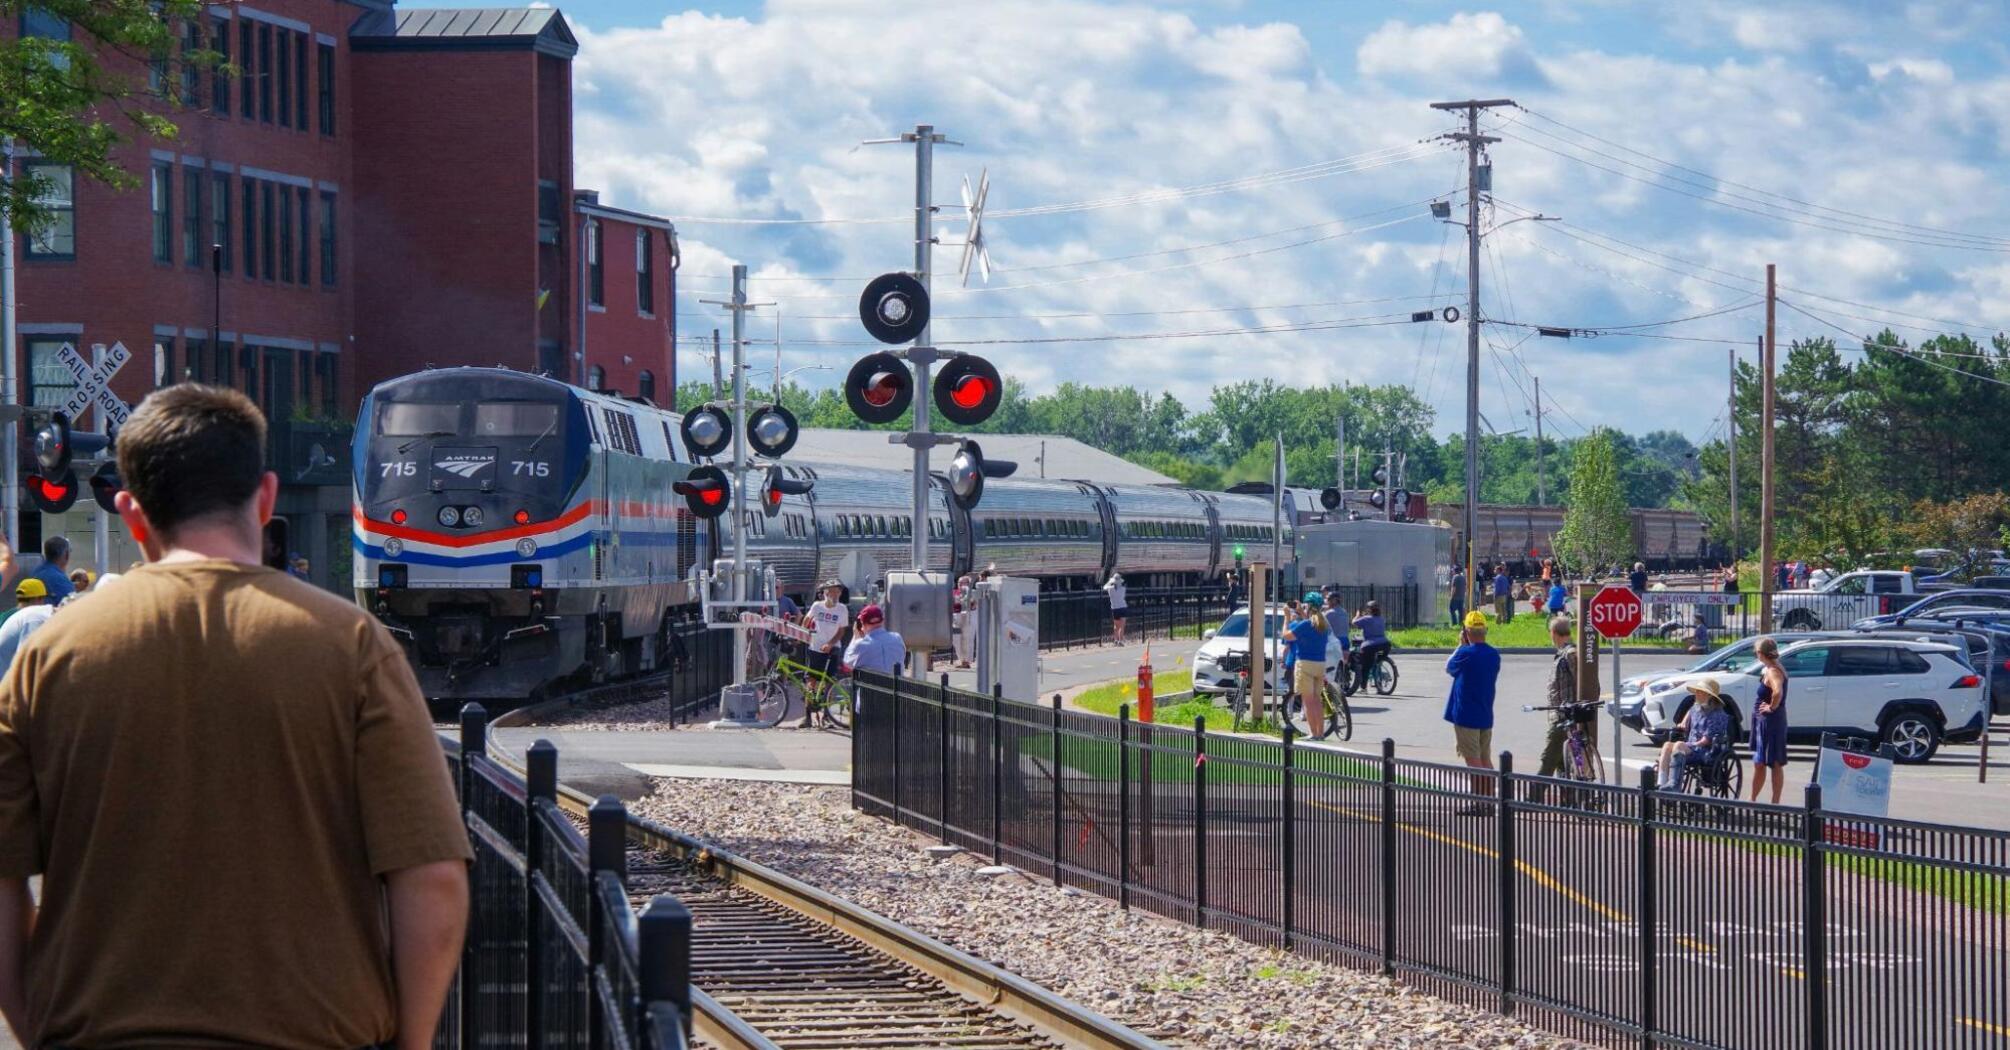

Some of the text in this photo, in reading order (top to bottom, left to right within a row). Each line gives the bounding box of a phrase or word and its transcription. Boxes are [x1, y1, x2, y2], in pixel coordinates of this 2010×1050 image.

[57, 347, 86, 381] RAIL
[61, 350, 124, 418] ROSSING
[97, 391, 128, 425] ROAD
[380, 461, 417, 478] 715
[511, 461, 550, 478] 715
[1651, 594, 1730, 604] EMPLOYEES ONLY
[1594, 602, 1639, 623] STOP
[1586, 634, 1596, 663] Street
